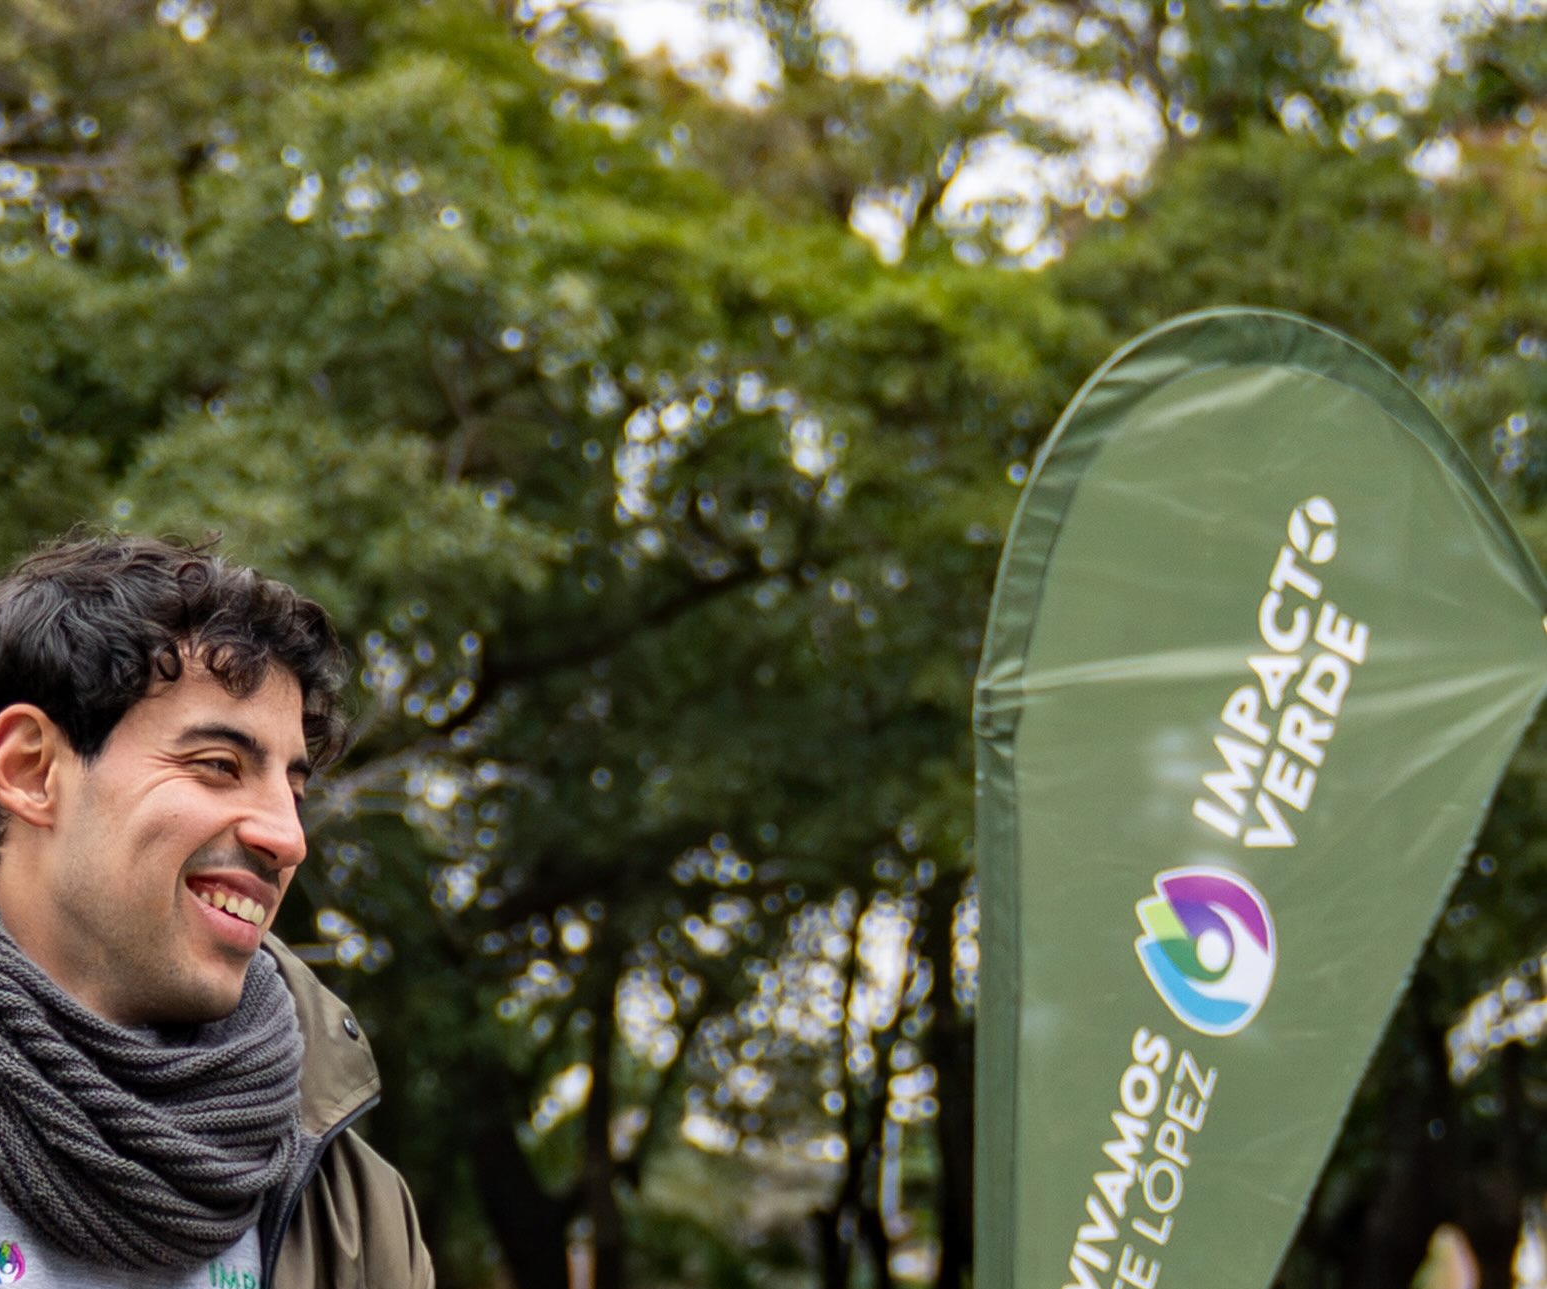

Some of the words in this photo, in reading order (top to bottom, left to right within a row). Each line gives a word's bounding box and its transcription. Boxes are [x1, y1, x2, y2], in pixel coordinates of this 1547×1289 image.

[1191, 495, 1339, 839] IMPACTO
[1242, 602, 1370, 848] VERDE
[1131, 1050, 1219, 1246] LÓPEZ
